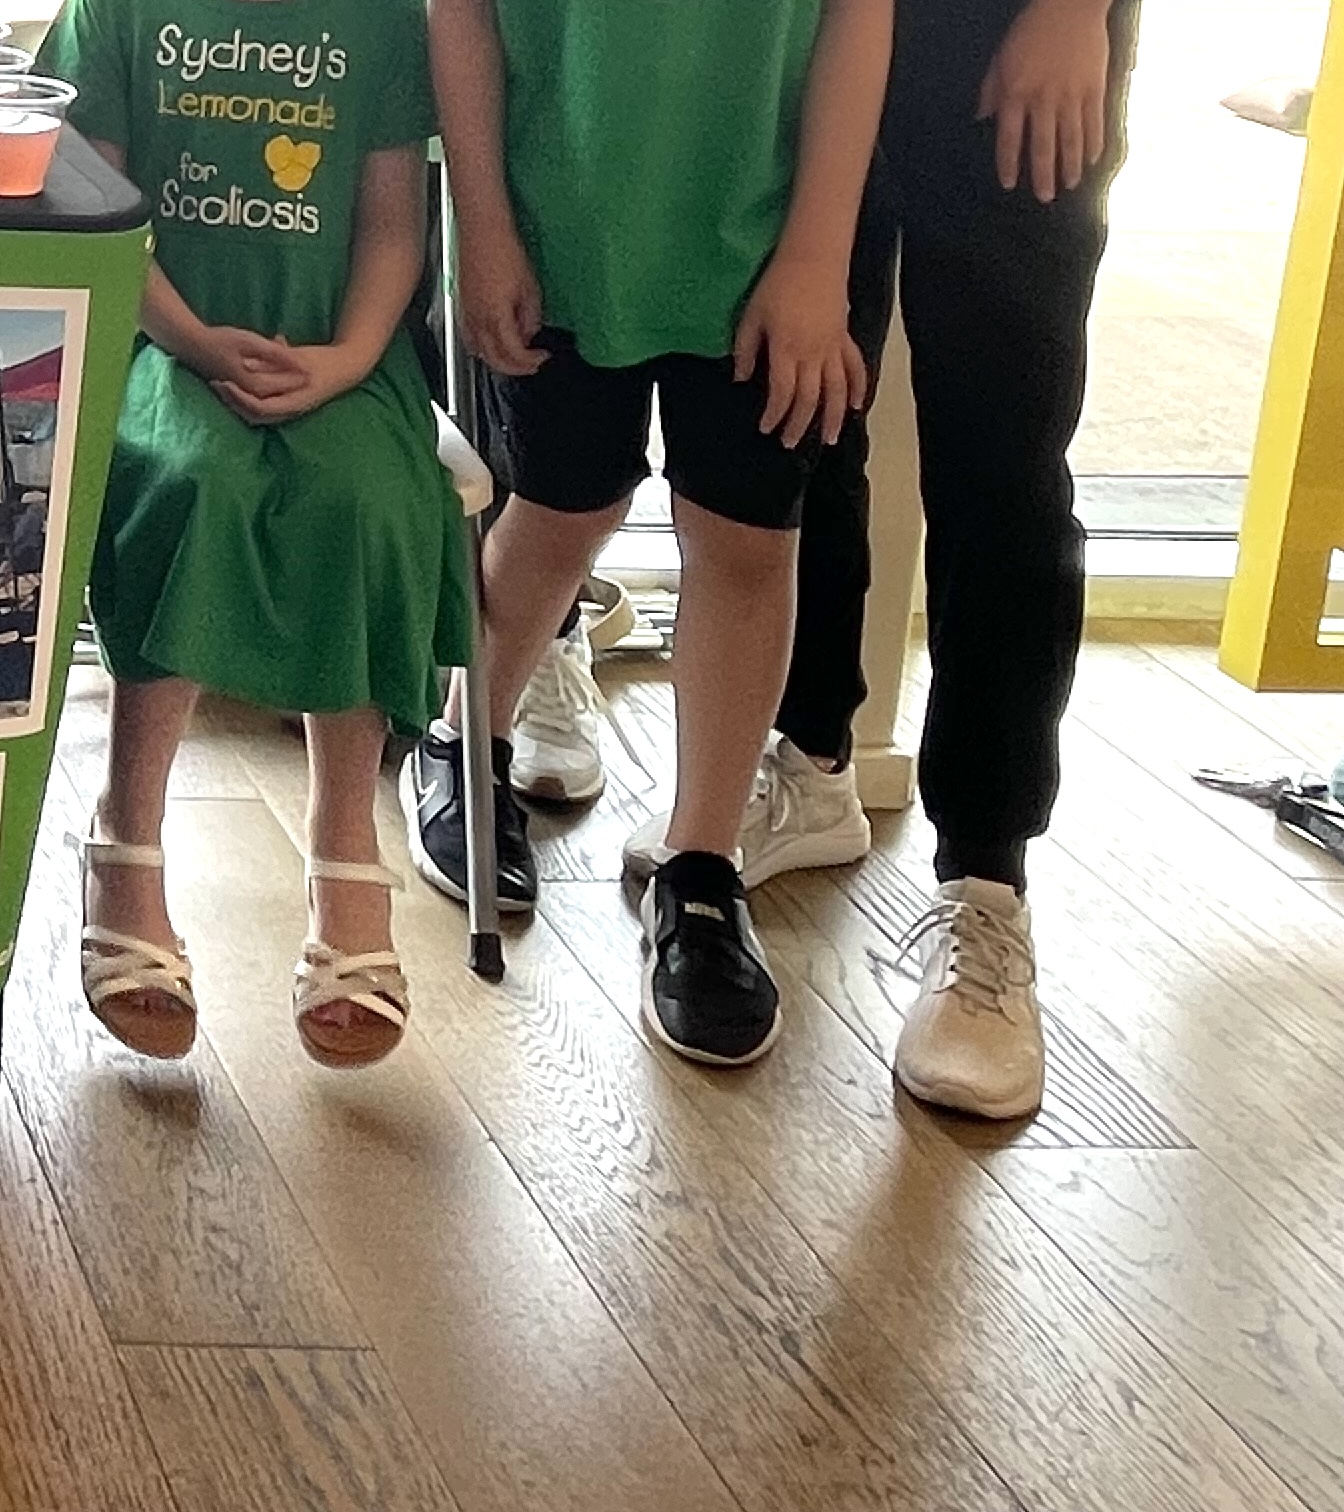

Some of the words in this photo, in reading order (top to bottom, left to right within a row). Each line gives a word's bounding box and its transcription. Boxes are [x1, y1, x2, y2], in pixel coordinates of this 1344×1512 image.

[156, 23, 347, 88] Sydney's
[157, 78, 336, 130] Lemonade
[179, 151, 218, 183] for
[160, 178, 320, 234] Scoliosis
